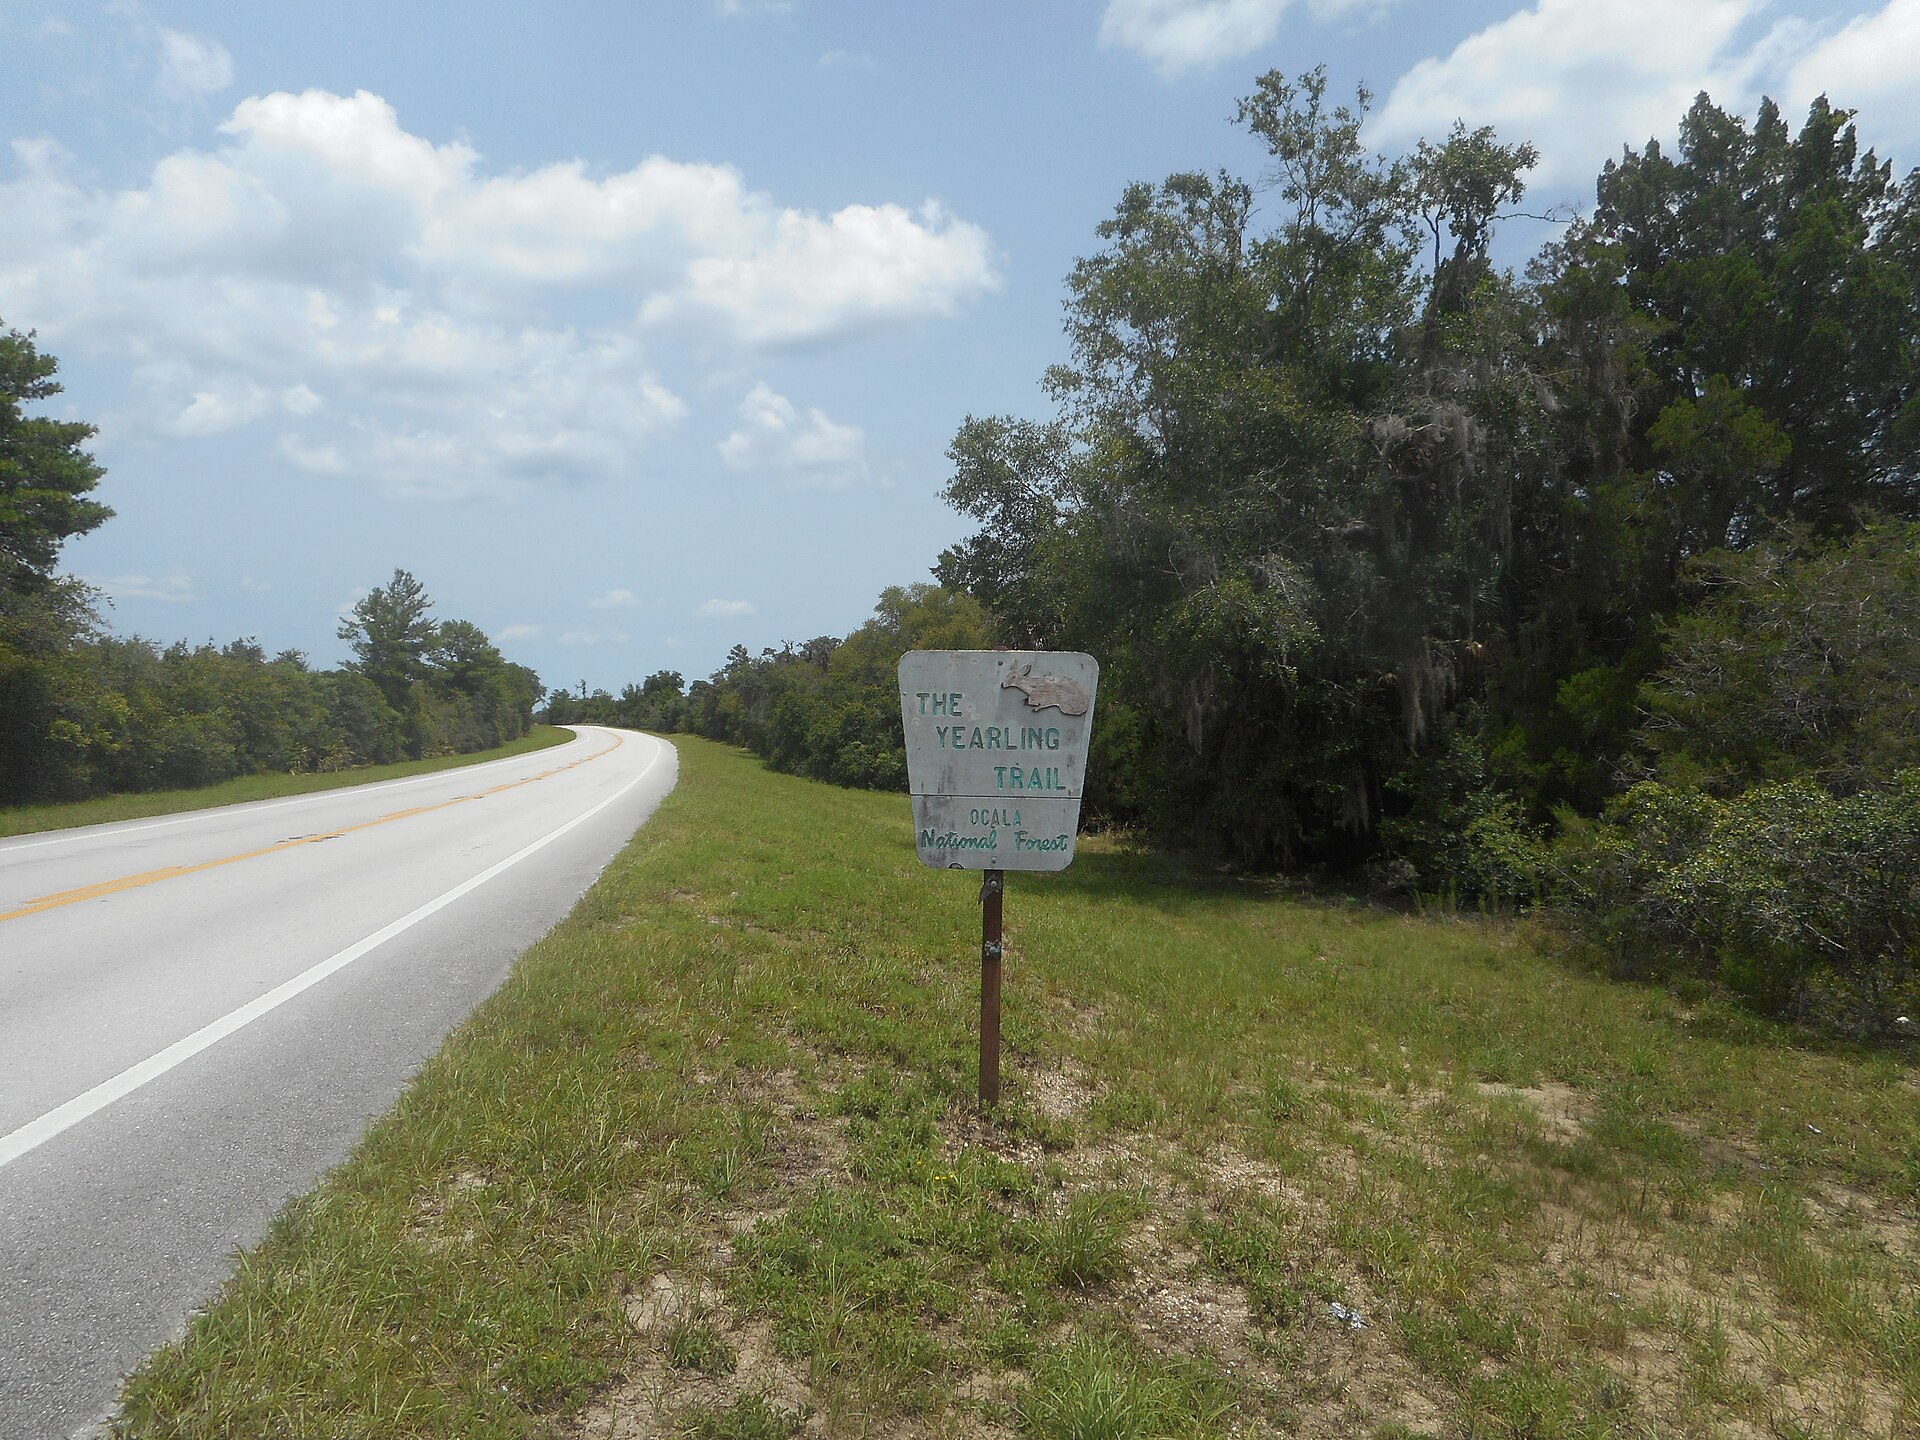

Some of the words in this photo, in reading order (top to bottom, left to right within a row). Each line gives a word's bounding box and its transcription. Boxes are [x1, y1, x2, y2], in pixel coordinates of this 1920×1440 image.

[916, 692, 963, 716] THE
[936, 726, 1060, 750] YEARLING
[994, 766, 1066, 790] TRAIL
[970, 808, 1022, 827] OCALA
[921, 828, 998, 850] National
[1014, 830, 1069, 852] Forest
